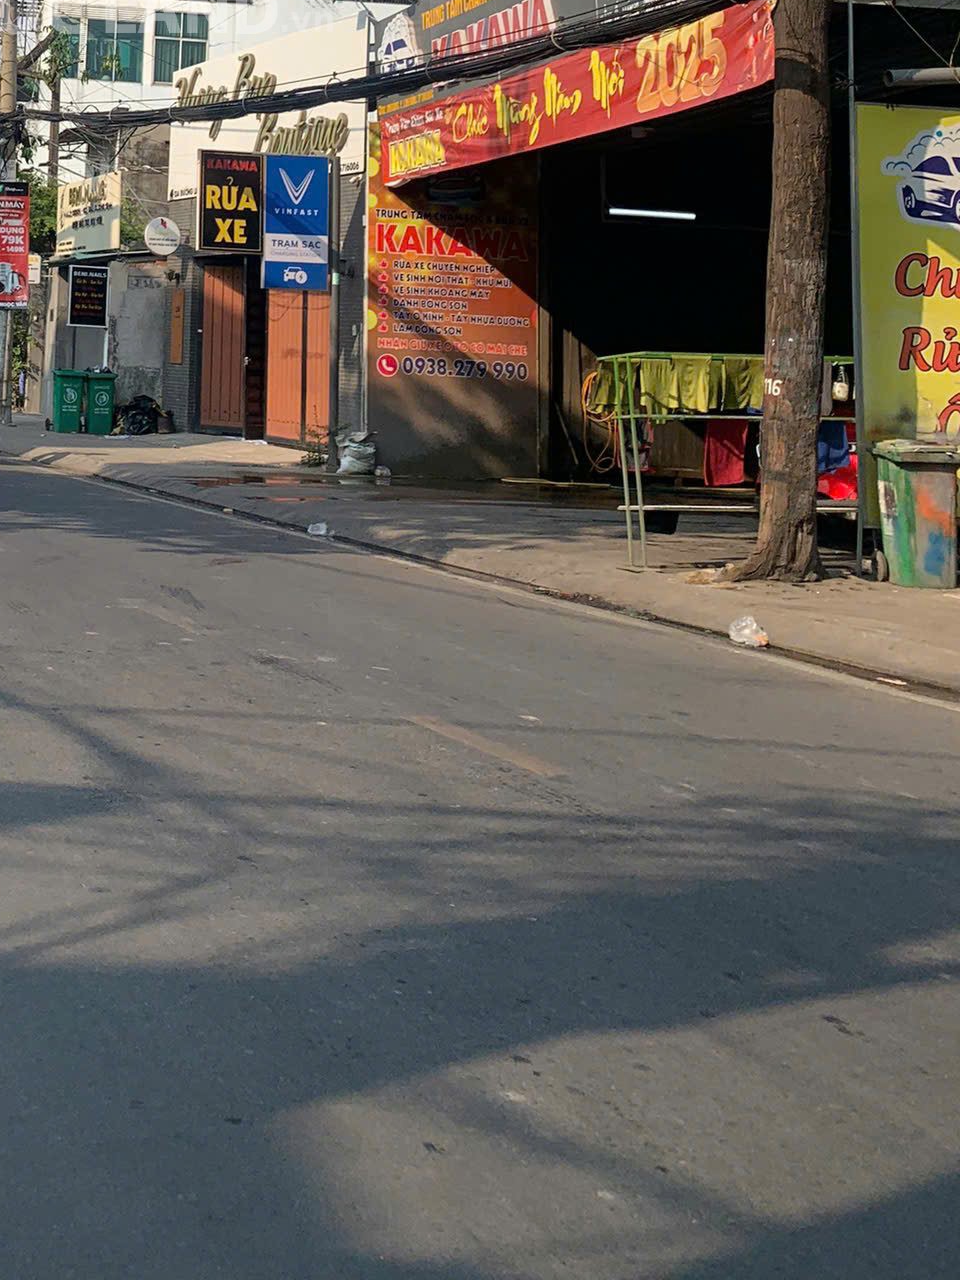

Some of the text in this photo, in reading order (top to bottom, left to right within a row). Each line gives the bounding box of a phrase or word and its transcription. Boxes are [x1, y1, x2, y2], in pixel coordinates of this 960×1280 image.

[421, 4, 444, 32] TRUNG
[452, 102, 489, 143] Chúc
[636, 8, 728, 114] 2025
[207, 159, 258, 172] KAKAWA
[205, 176, 258, 212] RỬA
[274, 207, 320, 216] VINFAST
[376, 208, 408, 219] TRUNG
[1, 235, 24, 244] 79K
[214, 218, 248, 244] XE
[376, 222, 528, 263] KAKAWA
[414, 261, 425, 270] XE
[894, 252, 960, 298] Ch
[406, 273, 426, 283] SINH
[406, 287, 426, 297] SINH
[428, 288, 468, 298] KHOANG
[402, 356, 529, 381] 0938.279 990
